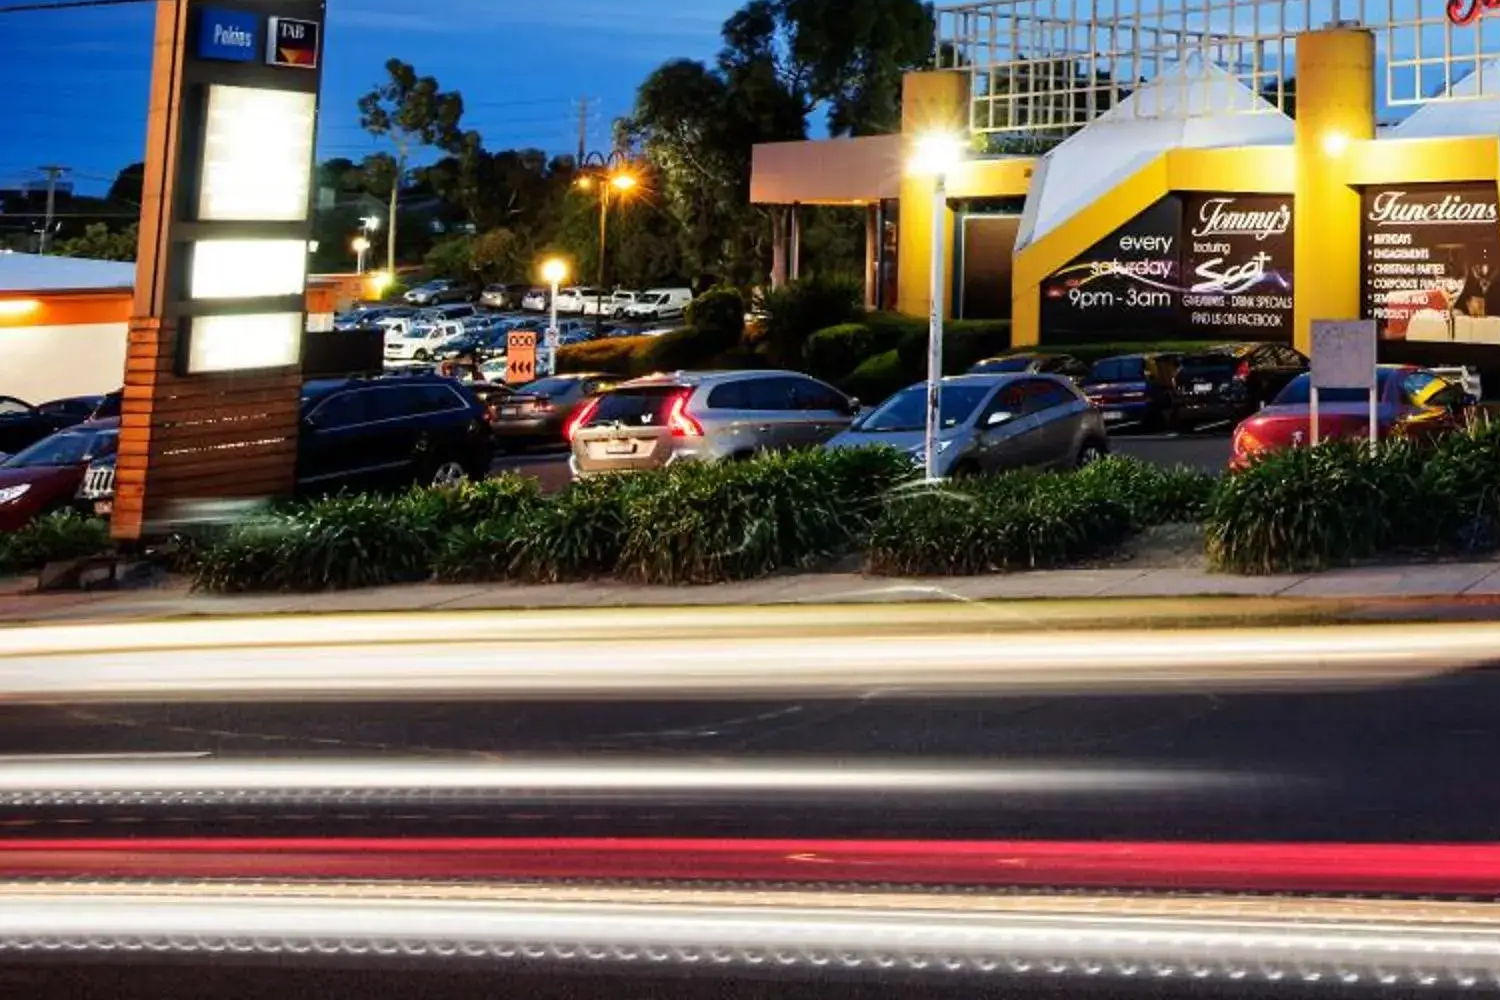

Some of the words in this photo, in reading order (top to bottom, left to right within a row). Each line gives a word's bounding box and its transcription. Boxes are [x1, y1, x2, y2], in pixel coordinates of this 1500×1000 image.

[213, 23, 253, 48] Pokies
[280, 22, 305, 39] TAB
[1368, 191, 1498, 227] Functions
[1191, 198, 1290, 241] Tommy's
[1119, 235, 1173, 254] every
[1193, 242, 1231, 256] featuring
[1089, 257, 1173, 279] saturday
[1068, 288, 1114, 309] 9pm
[1126, 288, 1171, 306] 3am
[1256, 295, 1293, 309] SPECIALS
[1191, 312, 1210, 325] FIND
[1211, 313, 1222, 325] US
[1224, 313, 1237, 325] ON
[1238, 313, 1283, 327] FACEBOOK
